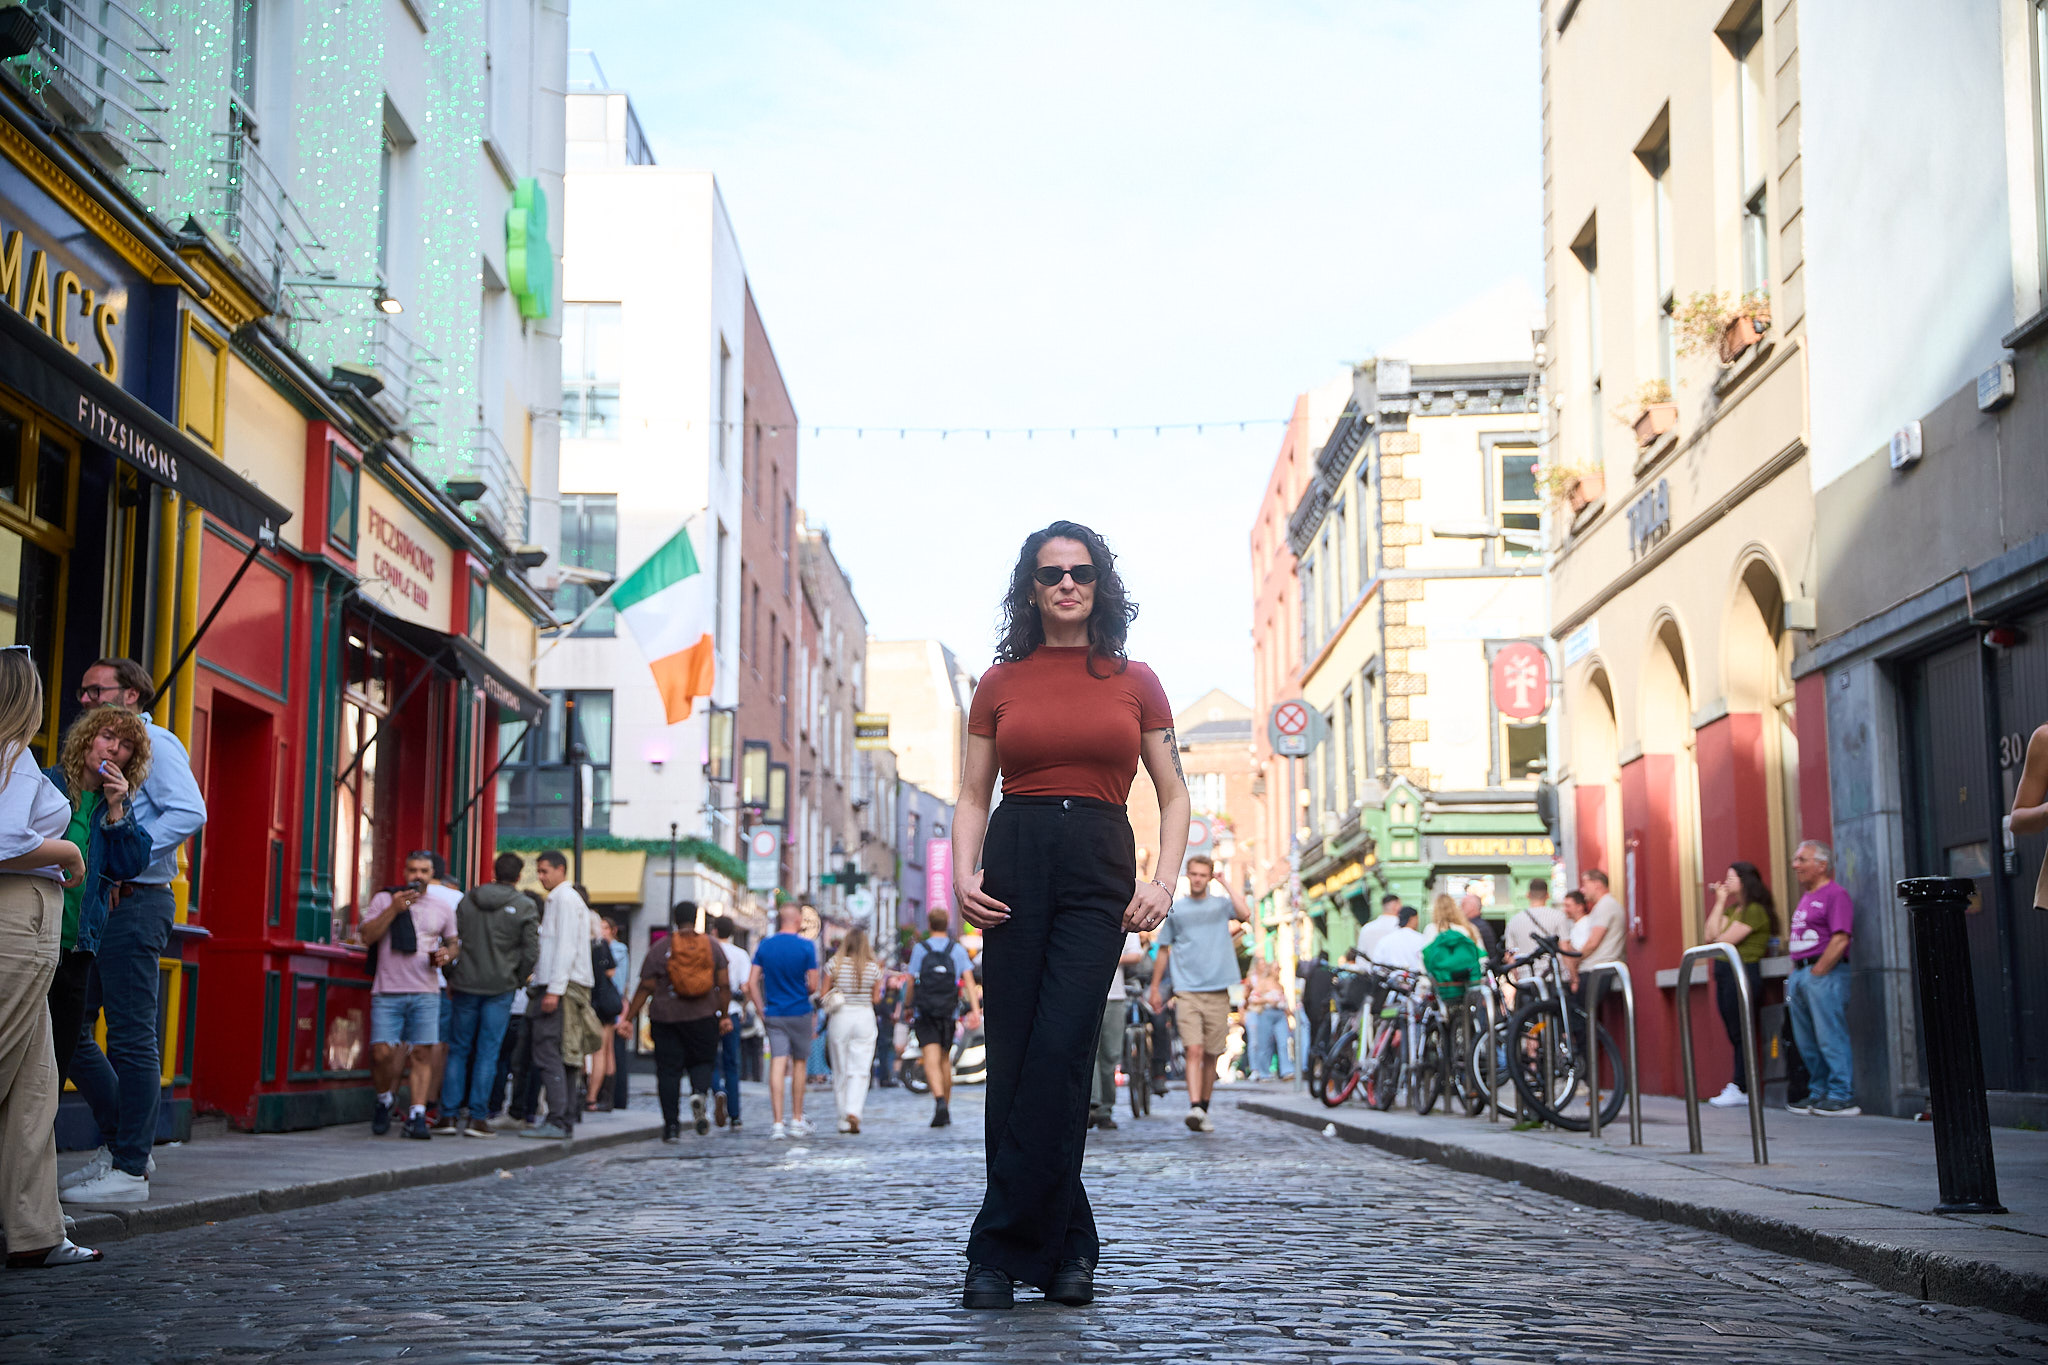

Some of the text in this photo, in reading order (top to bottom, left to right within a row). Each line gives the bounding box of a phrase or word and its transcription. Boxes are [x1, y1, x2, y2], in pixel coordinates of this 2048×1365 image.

[78, 394, 178, 483] FITZSIMONS
[2000, 732, 2023, 767] 30
[1443, 838, 1556, 856] TEMPLE BA
